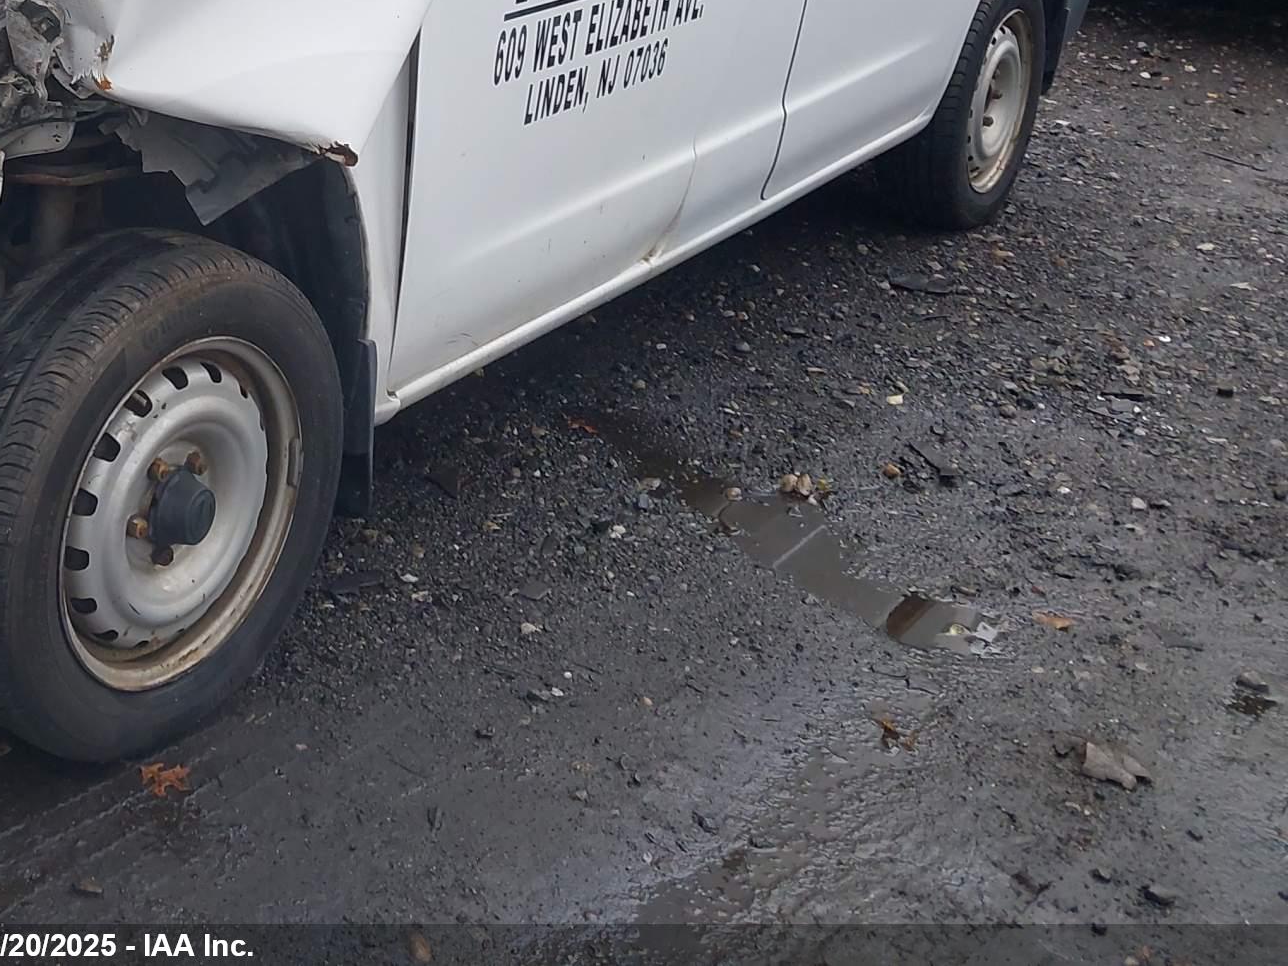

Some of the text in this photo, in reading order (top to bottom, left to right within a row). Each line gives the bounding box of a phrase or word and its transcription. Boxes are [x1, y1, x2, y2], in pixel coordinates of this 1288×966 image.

[493, 24, 527, 86] 609
[532, 9, 583, 73] WEST
[523, 37, 669, 126] LINDEN, NJ 07036
